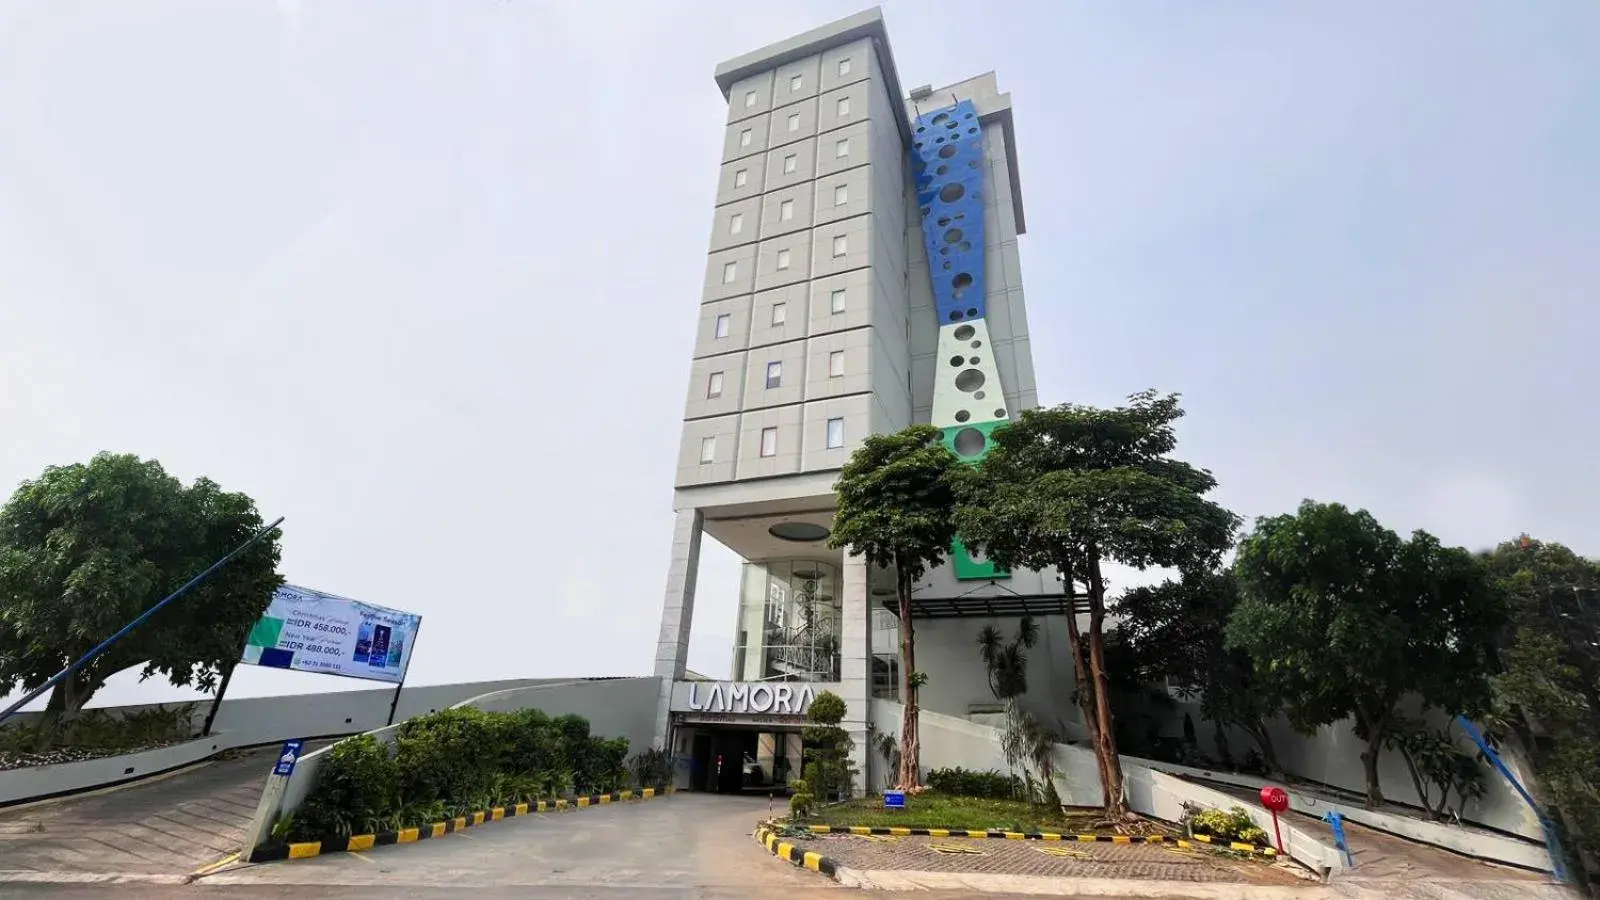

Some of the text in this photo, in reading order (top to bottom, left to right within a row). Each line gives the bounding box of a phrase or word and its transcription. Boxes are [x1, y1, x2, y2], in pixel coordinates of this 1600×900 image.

[294, 618, 312, 629] IDR
[286, 641, 304, 651] IDR
[689, 682, 816, 713] LAMORA
[1271, 794, 1285, 803] OUT
